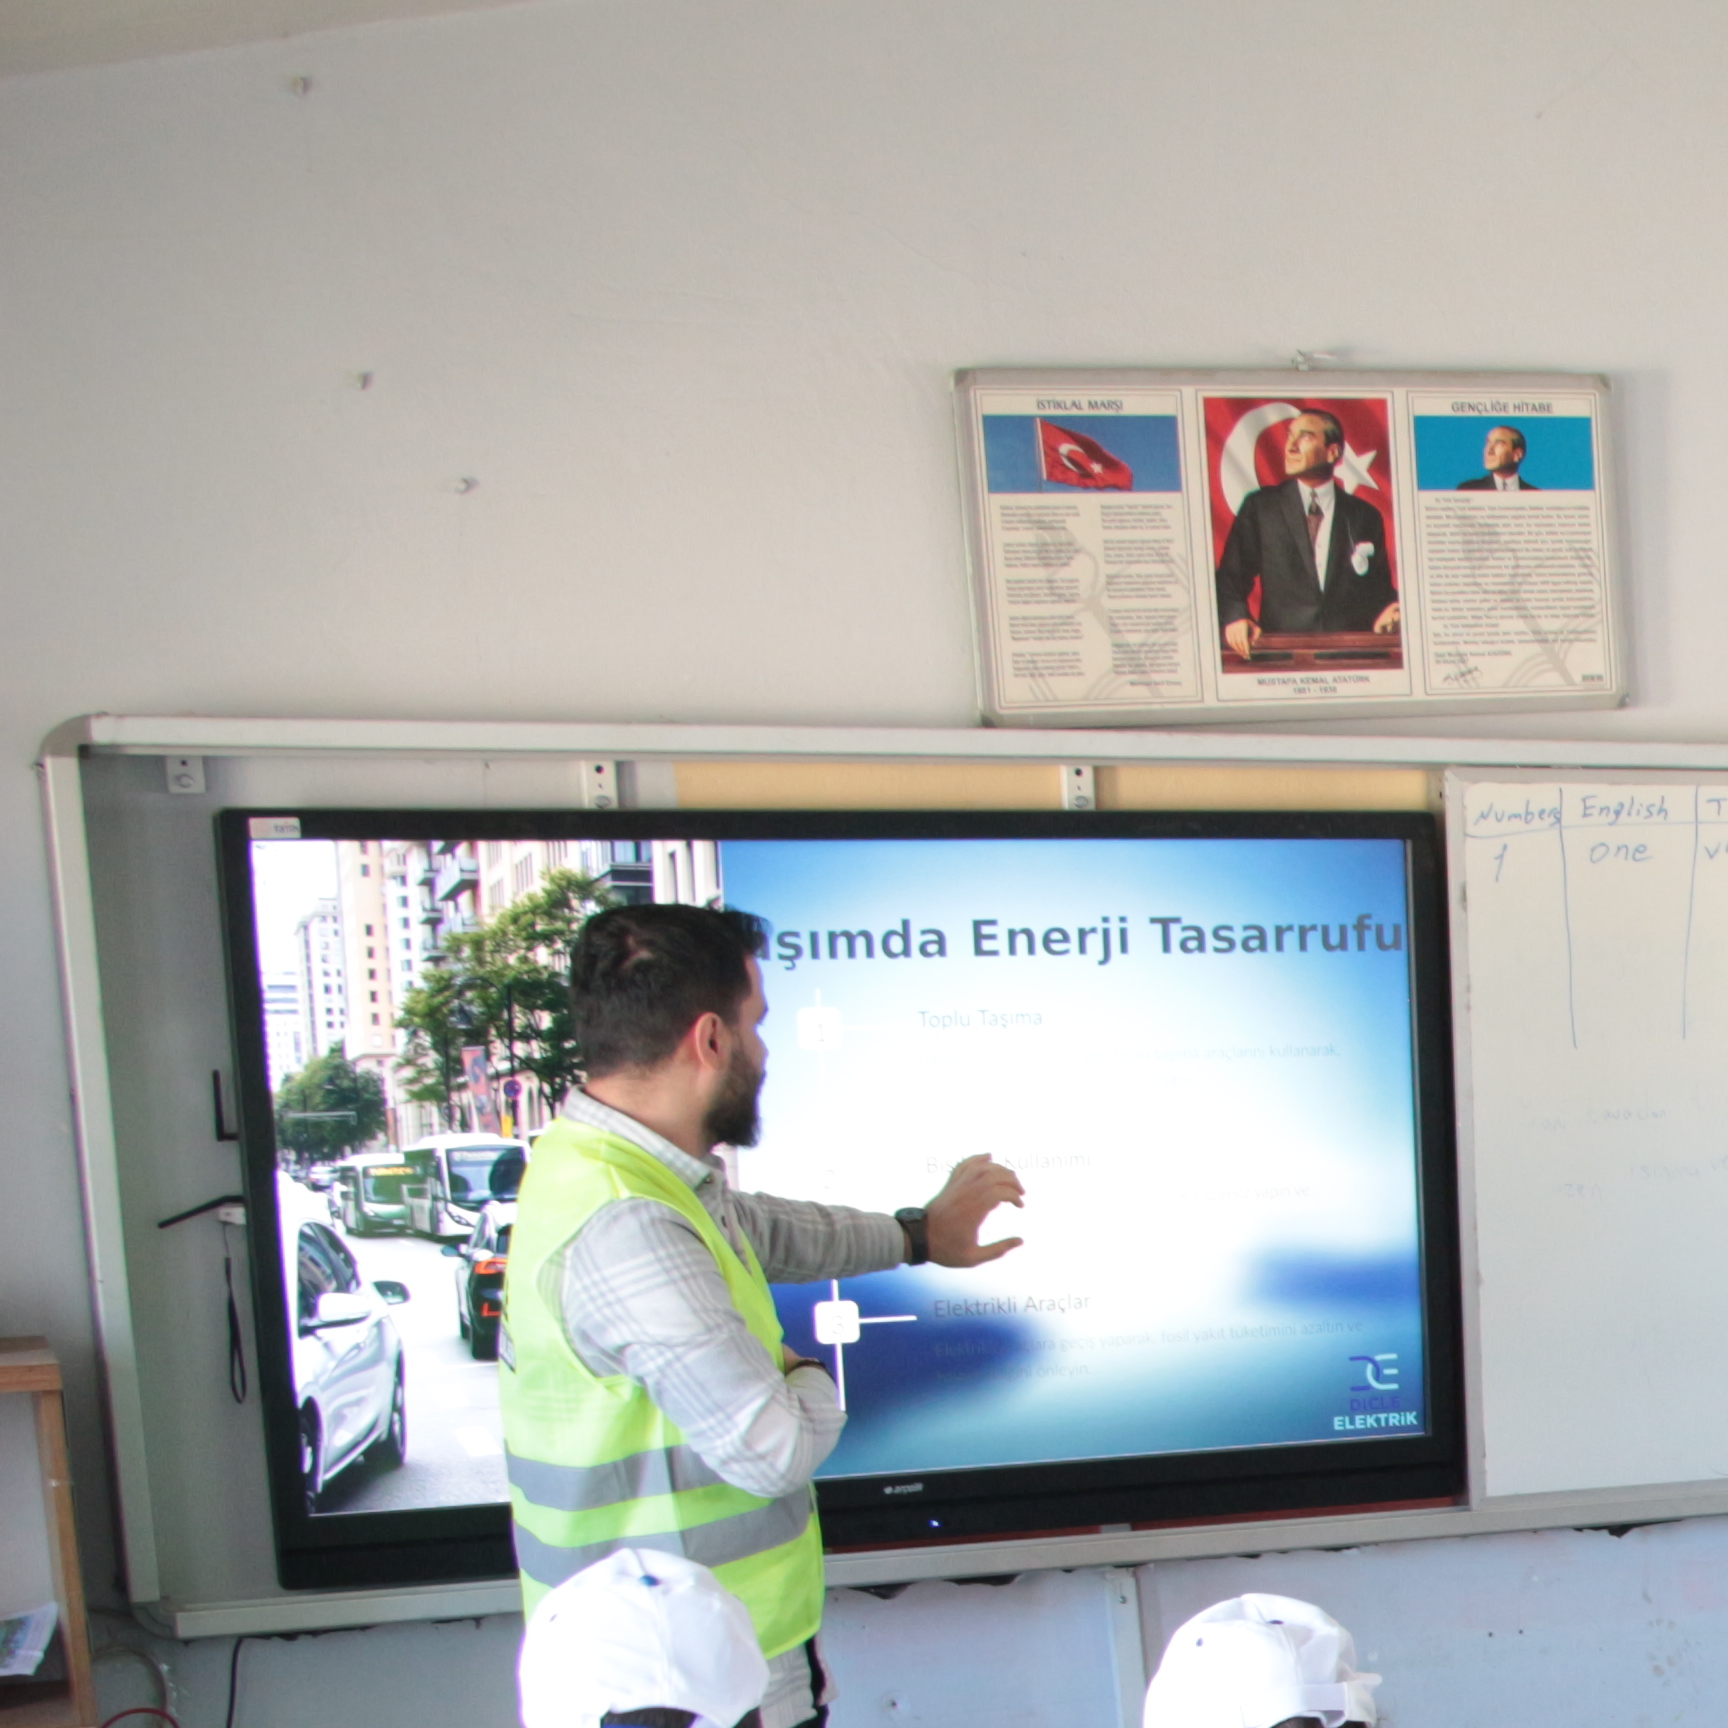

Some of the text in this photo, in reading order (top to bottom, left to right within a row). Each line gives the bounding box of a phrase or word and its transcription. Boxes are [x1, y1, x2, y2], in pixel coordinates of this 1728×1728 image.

[1036, 396, 1123, 413] İSTİKLAL MARŞI
[1450, 399, 1554, 416] GENÇLİĞE HİTABE
[1581, 796, 1669, 823] English
[1590, 842, 1654, 866] one
[971, 915, 1130, 966] Enerji
[1149, 911, 1405, 956] Tasarrufu
[917, 1009, 972, 1030] Toplu
[976, 1007, 1044, 1031] Taşıma
[933, 1297, 1019, 1320] Elektrikli
[1023, 1292, 1092, 1318] Araçlar
[1347, 1319, 1363, 1333] ve
